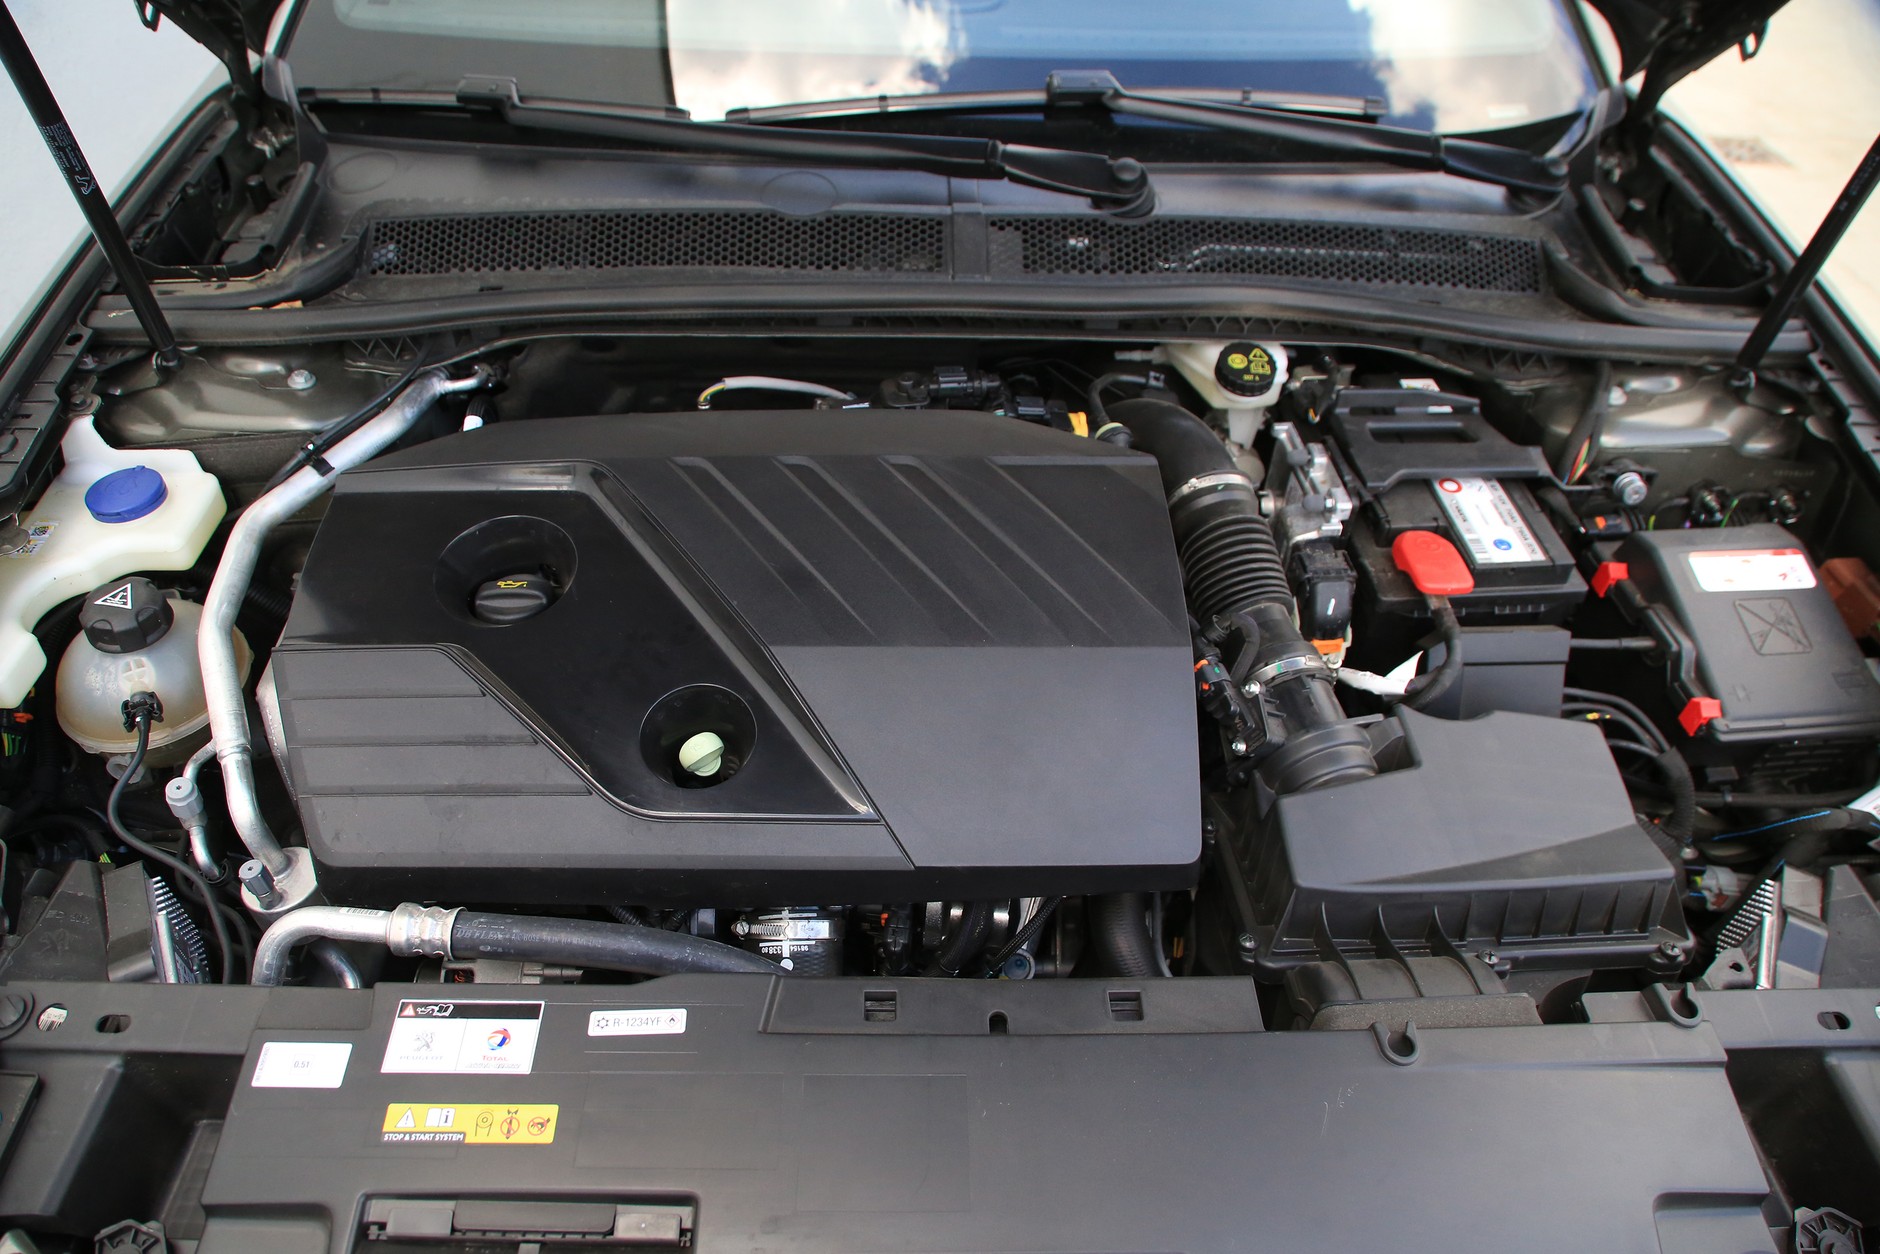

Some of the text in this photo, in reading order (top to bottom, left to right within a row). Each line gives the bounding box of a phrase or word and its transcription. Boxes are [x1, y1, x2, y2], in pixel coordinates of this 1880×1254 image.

[613, 1016, 662, 1028] R-1234YF
[384, 1133, 404, 1141] STOP
[411, 1133, 435, 1141] START
[435, 1133, 464, 1141] SYSTEM
